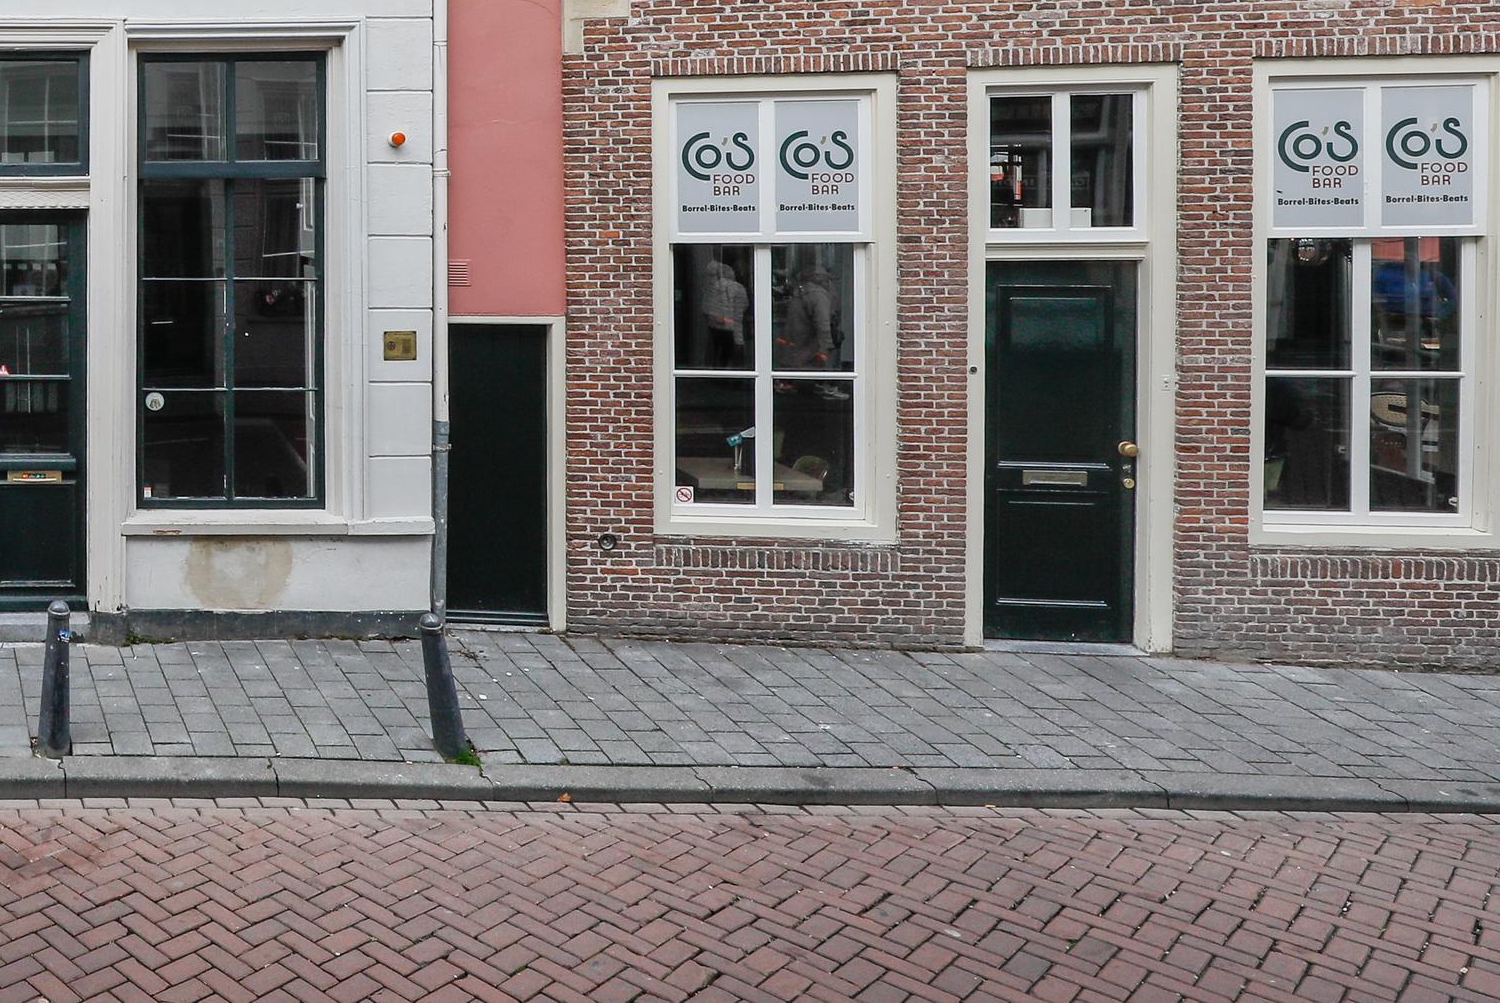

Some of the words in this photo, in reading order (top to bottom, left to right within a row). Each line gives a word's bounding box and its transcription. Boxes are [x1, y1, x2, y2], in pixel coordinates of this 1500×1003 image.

[1312, 165, 1358, 176] FOOD
[1421, 162, 1468, 173] FOOD
[713, 174, 755, 184] FOOD
[812, 173, 854, 183] FOOD
[1312, 177, 1342, 188] BAR
[1421, 174, 1451, 185] BAR
[713, 185, 740, 196] BAR
[811, 184, 839, 195] BAR
